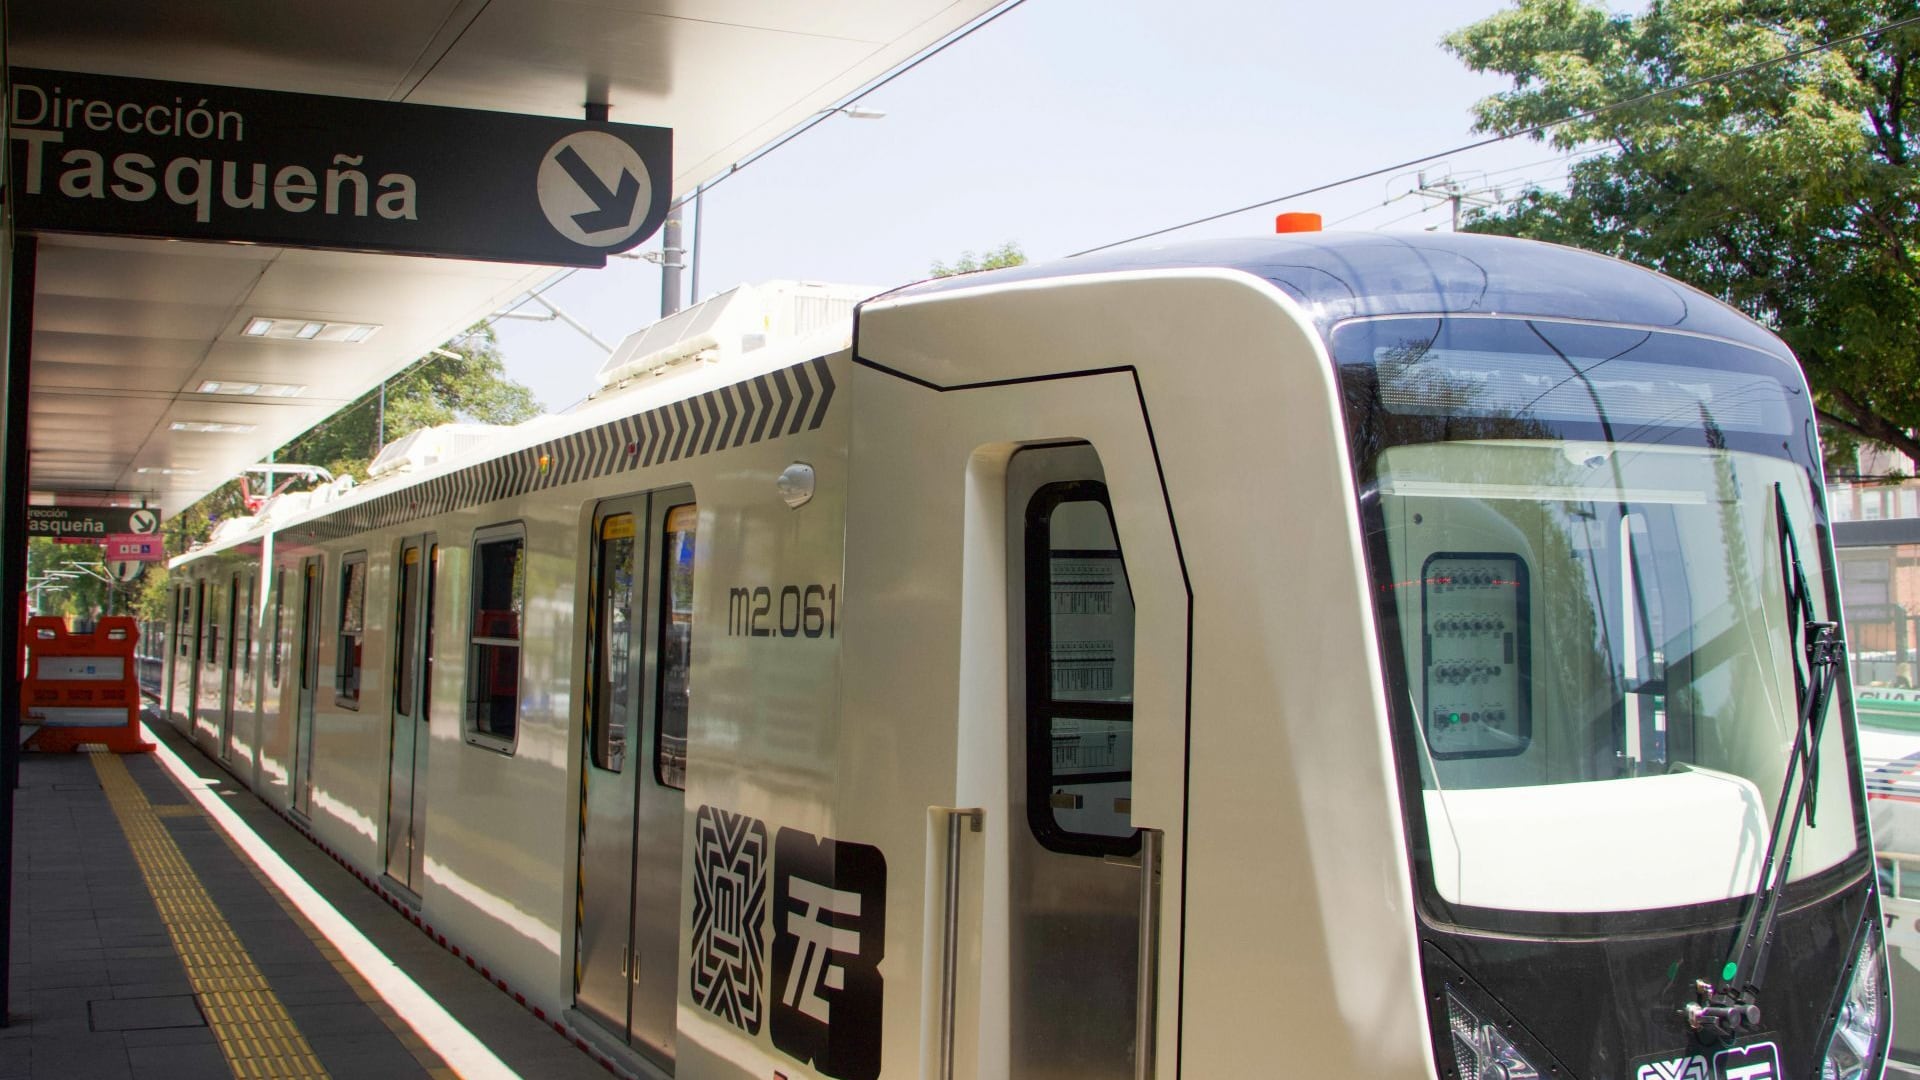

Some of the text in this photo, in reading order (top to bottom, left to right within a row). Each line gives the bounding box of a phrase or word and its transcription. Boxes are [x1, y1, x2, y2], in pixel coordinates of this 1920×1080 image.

[11, 83, 244, 142] Dirección
[10, 127, 419, 223] Tasqueña
[28, 508, 68, 518] rección
[29, 518, 105, 535] asqueña
[728, 583, 837, 639] m2.061
